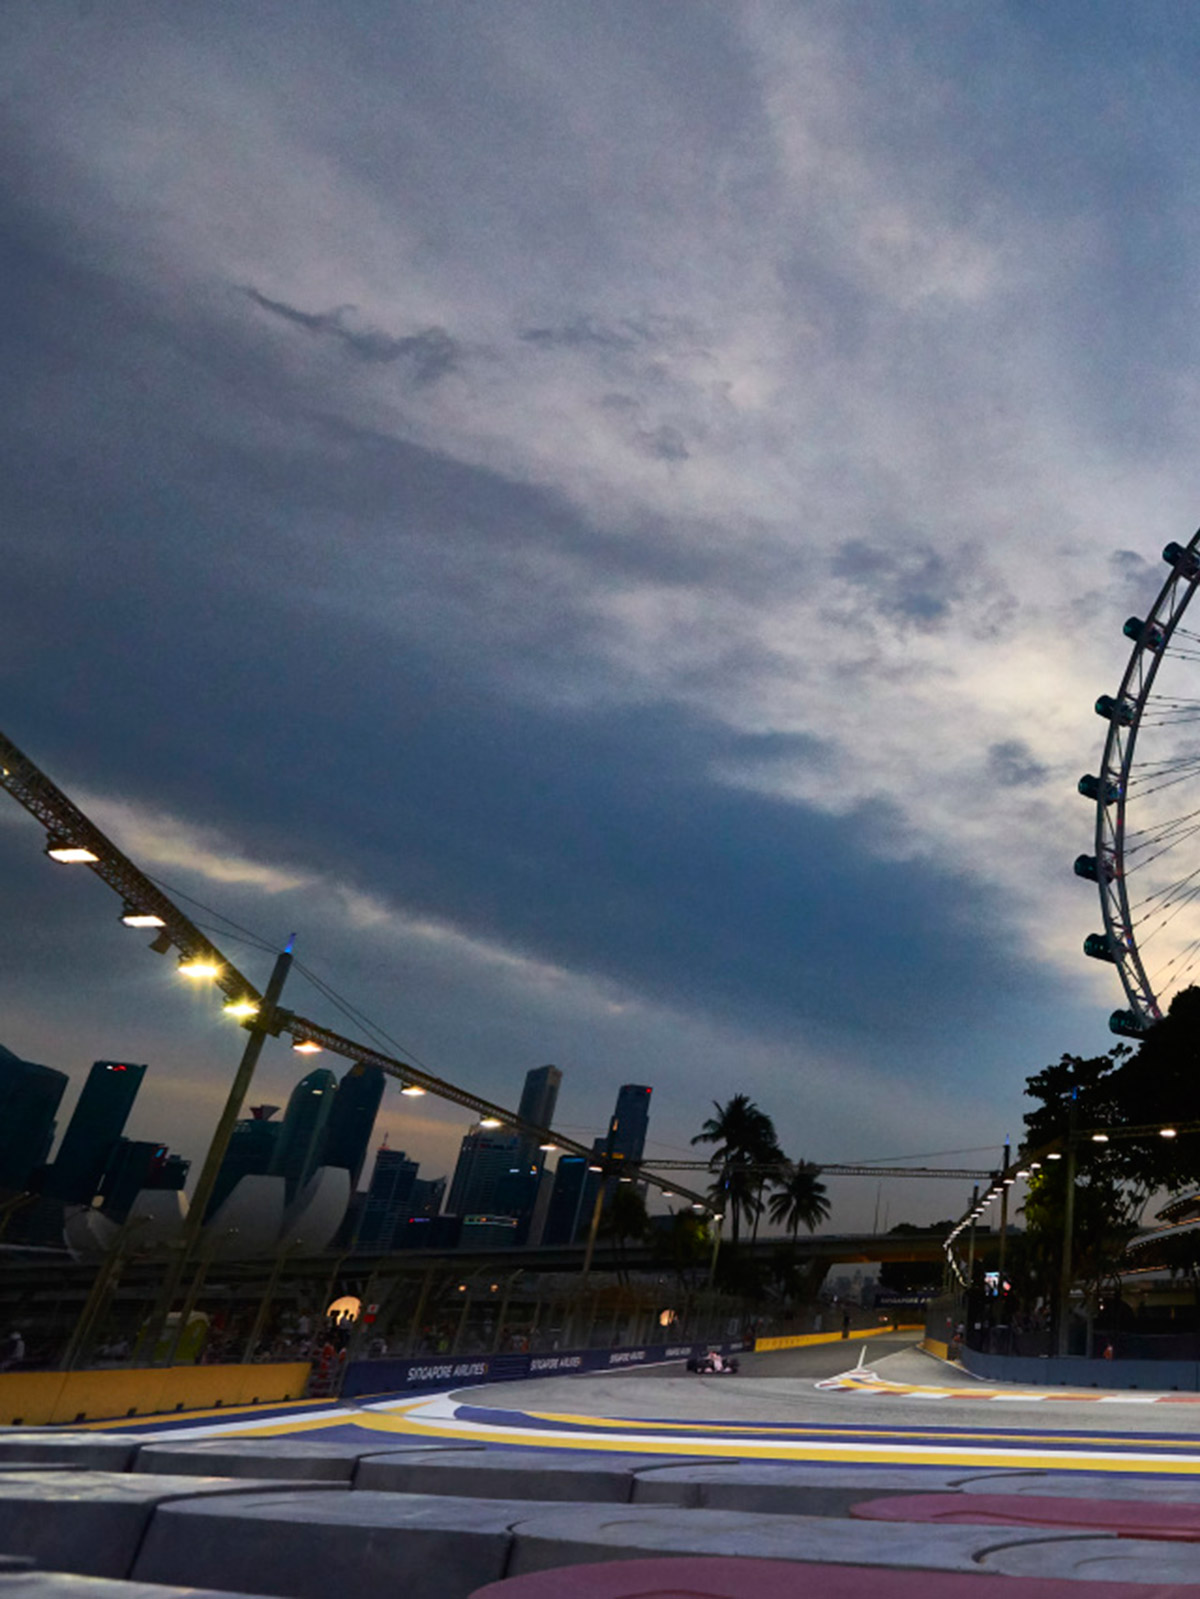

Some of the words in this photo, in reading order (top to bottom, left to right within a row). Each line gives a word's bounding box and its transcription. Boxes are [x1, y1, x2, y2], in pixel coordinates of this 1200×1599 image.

[407, 1366, 452, 1381] SINGAPORE
[453, 1363, 484, 1376] AIRLINES
[530, 1358, 560, 1371] SINGAPORE
